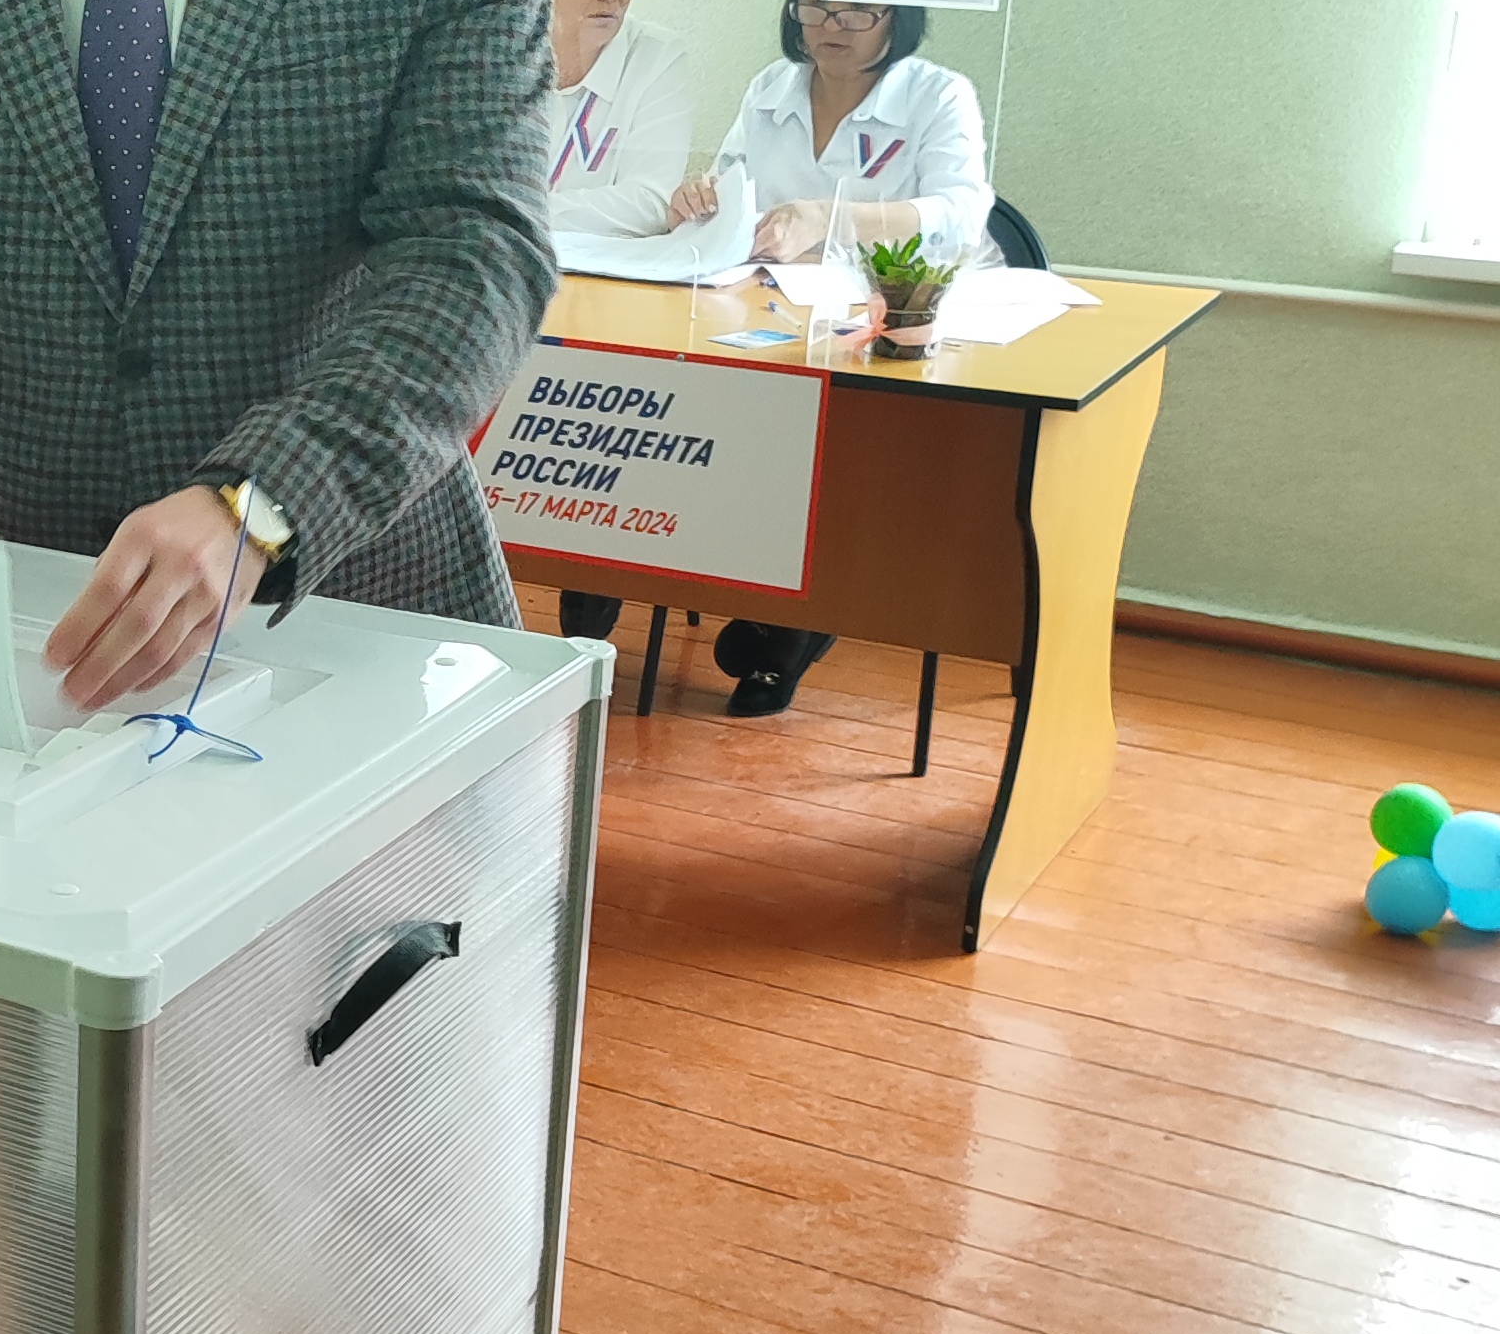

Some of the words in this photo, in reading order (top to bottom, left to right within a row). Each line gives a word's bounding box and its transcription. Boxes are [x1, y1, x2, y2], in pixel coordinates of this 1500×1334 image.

[527, 376, 675, 421] ВЫБОРЫ
[508, 413, 715, 467] ПРЕЗИДЕНТА
[491, 450, 623, 494] РОССИИ
[539, 494, 619, 528] МАРТА
[620, 507, 678, 537] 2024
